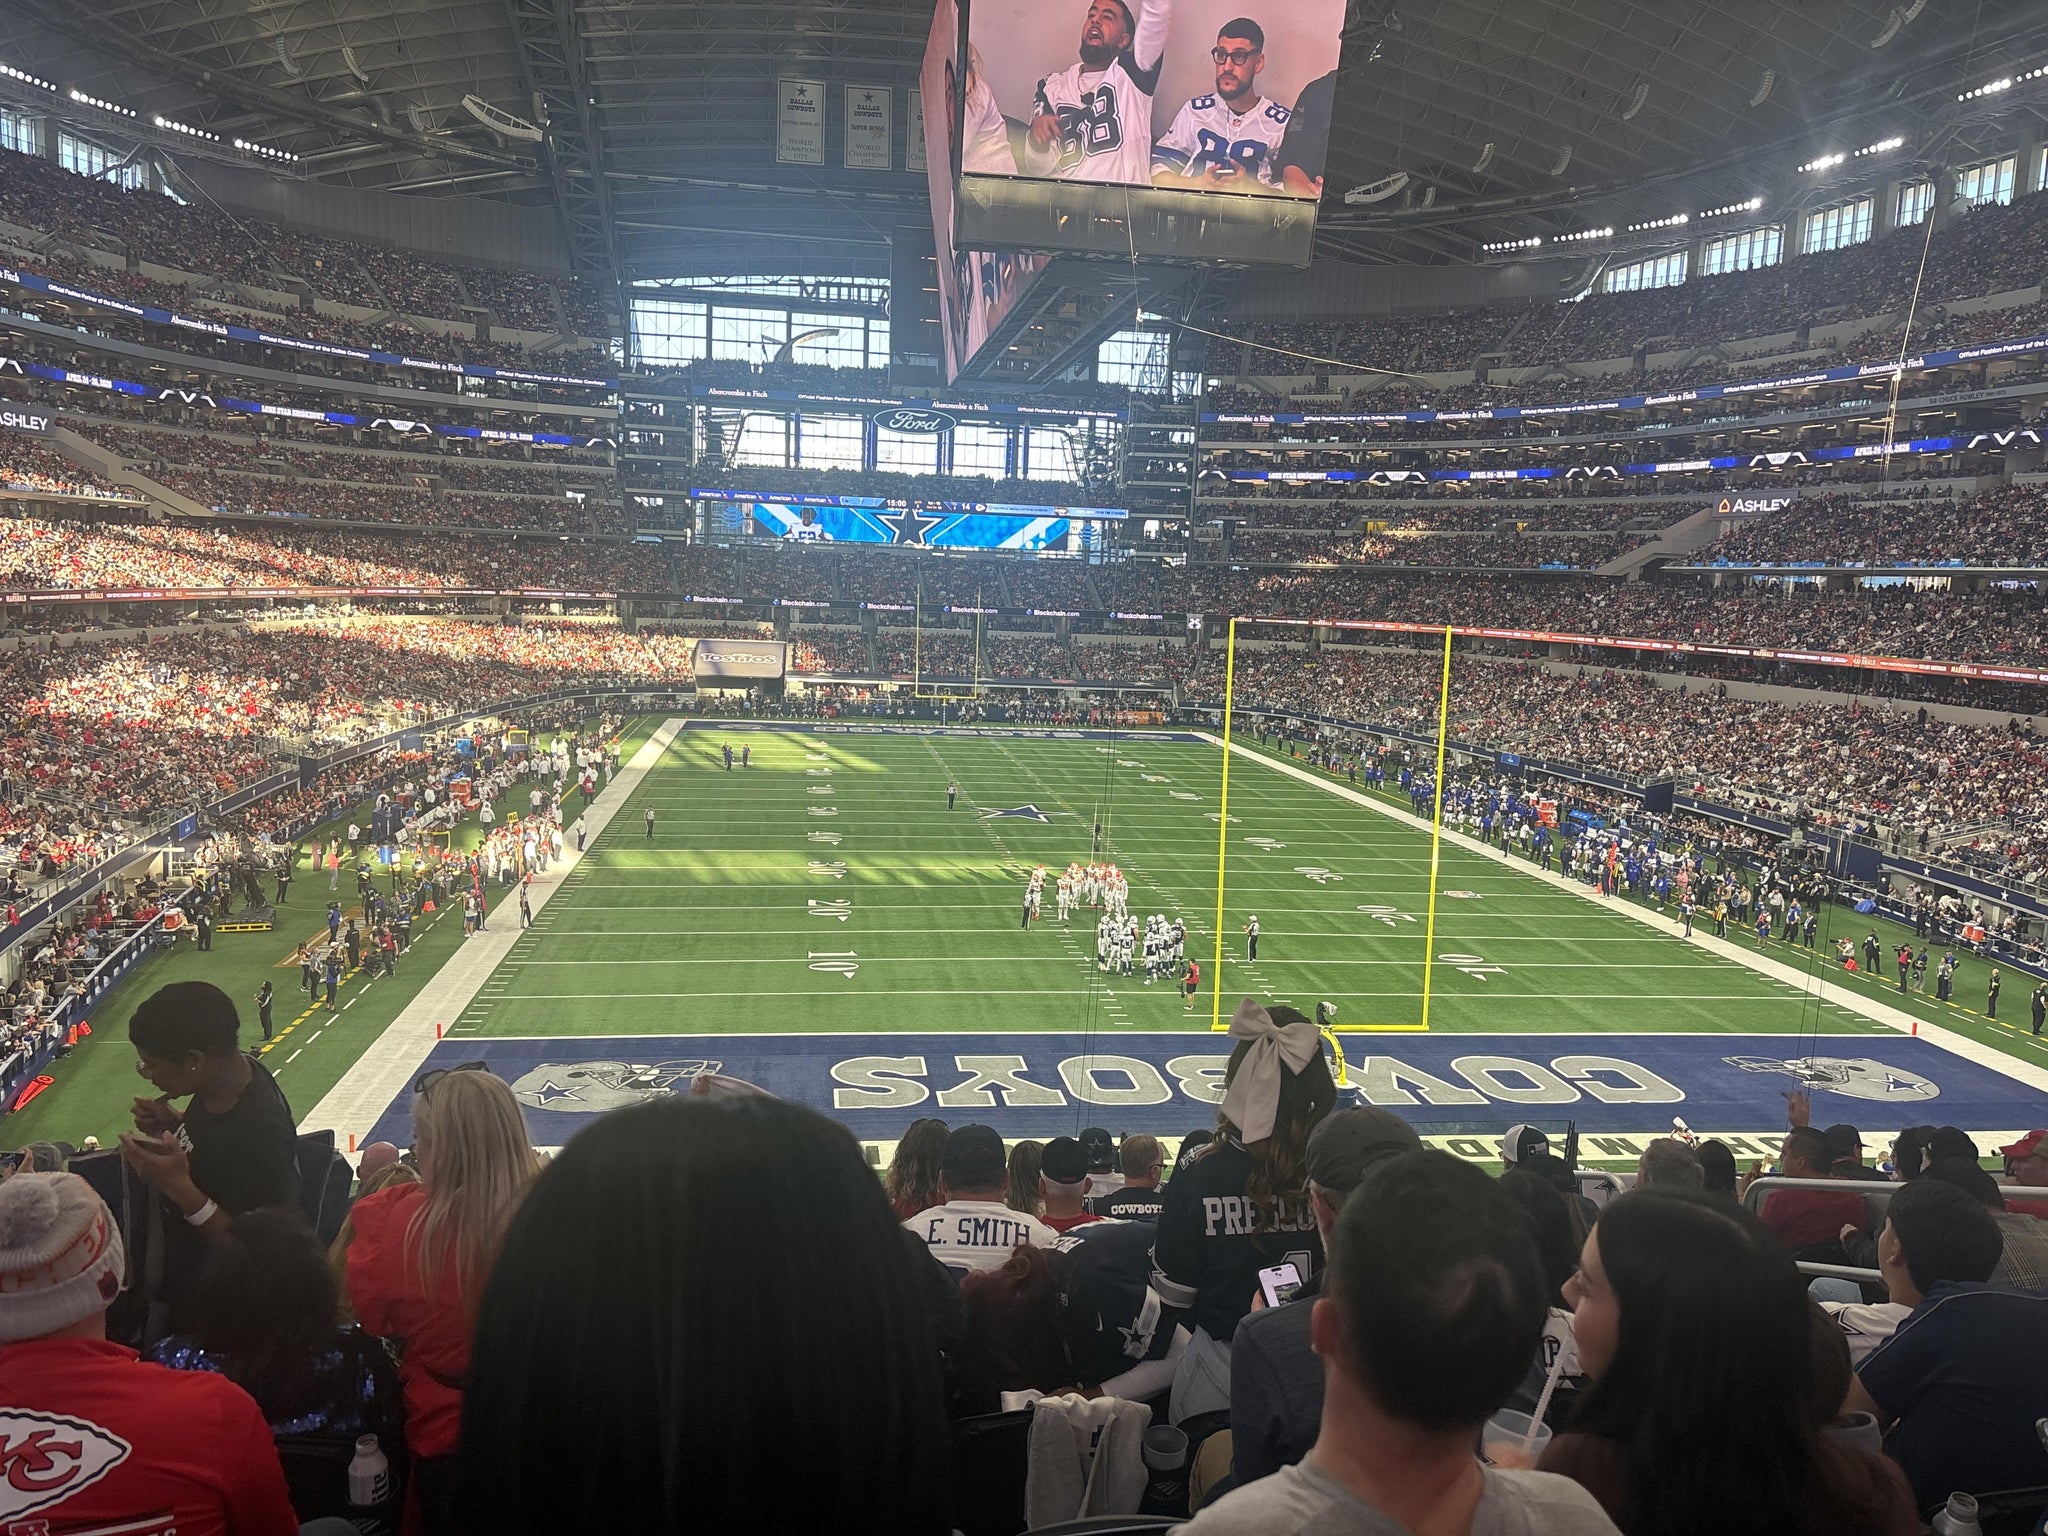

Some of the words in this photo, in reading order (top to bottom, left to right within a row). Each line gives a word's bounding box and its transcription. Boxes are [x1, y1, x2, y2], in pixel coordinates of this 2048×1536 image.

[790, 98, 813, 106] DALLAS
[787, 105, 816, 113] COWBOYS
[854, 110, 883, 118] COWBOYS
[788, 137, 813, 146] WORLD
[781, 144, 820, 154] CHAMPIONS
[856, 143, 880, 151] WORLD
[848, 150, 888, 159] CHAMPIONS
[258, 334, 277, 343] Official
[277, 337, 296, 346] Fashion
[296, 341, 314, 350] Partner
[331, 347, 346, 355] Dallas
[346, 349, 369, 359] Cowboys
[1958, 349, 1979, 359] Official
[1979, 346, 2002, 356] Fashion
[2002, 342, 2025, 352] Partner
[1959, 392, 1984, 400] HOWLEY
[889, 410, 940, 431] Ford
[886, 499, 907, 508] 15:00
[961, 503, 971, 511] 14
[1732, 498, 1791, 513] ASHLEY
[693, 596, 743, 605] Blockchain.com
[781, 599, 830, 608] Blockchain.com
[867, 602, 916, 611] Blockchain.com
[951, 606, 998, 615] Blockchain.com
[1034, 609, 1080, 617] Blockchain.com
[1117, 612, 1163, 620] Blockchain.com
[1188, 618, 1202, 629] 25
[813, 725, 1085, 739] COWBOYS
[807, 861, 848, 875] 30
[1293, 866, 1344, 881] 30
[807, 899, 853, 916] 20
[1356, 904, 1418, 922] 20
[807, 950, 860, 972] 10
[1437, 953, 1508, 975] 10
[830, 1054, 1686, 1110] COWBOYS
[927, 1218, 947, 1245] E.
[957, 1217, 1031, 1247] SMITH
